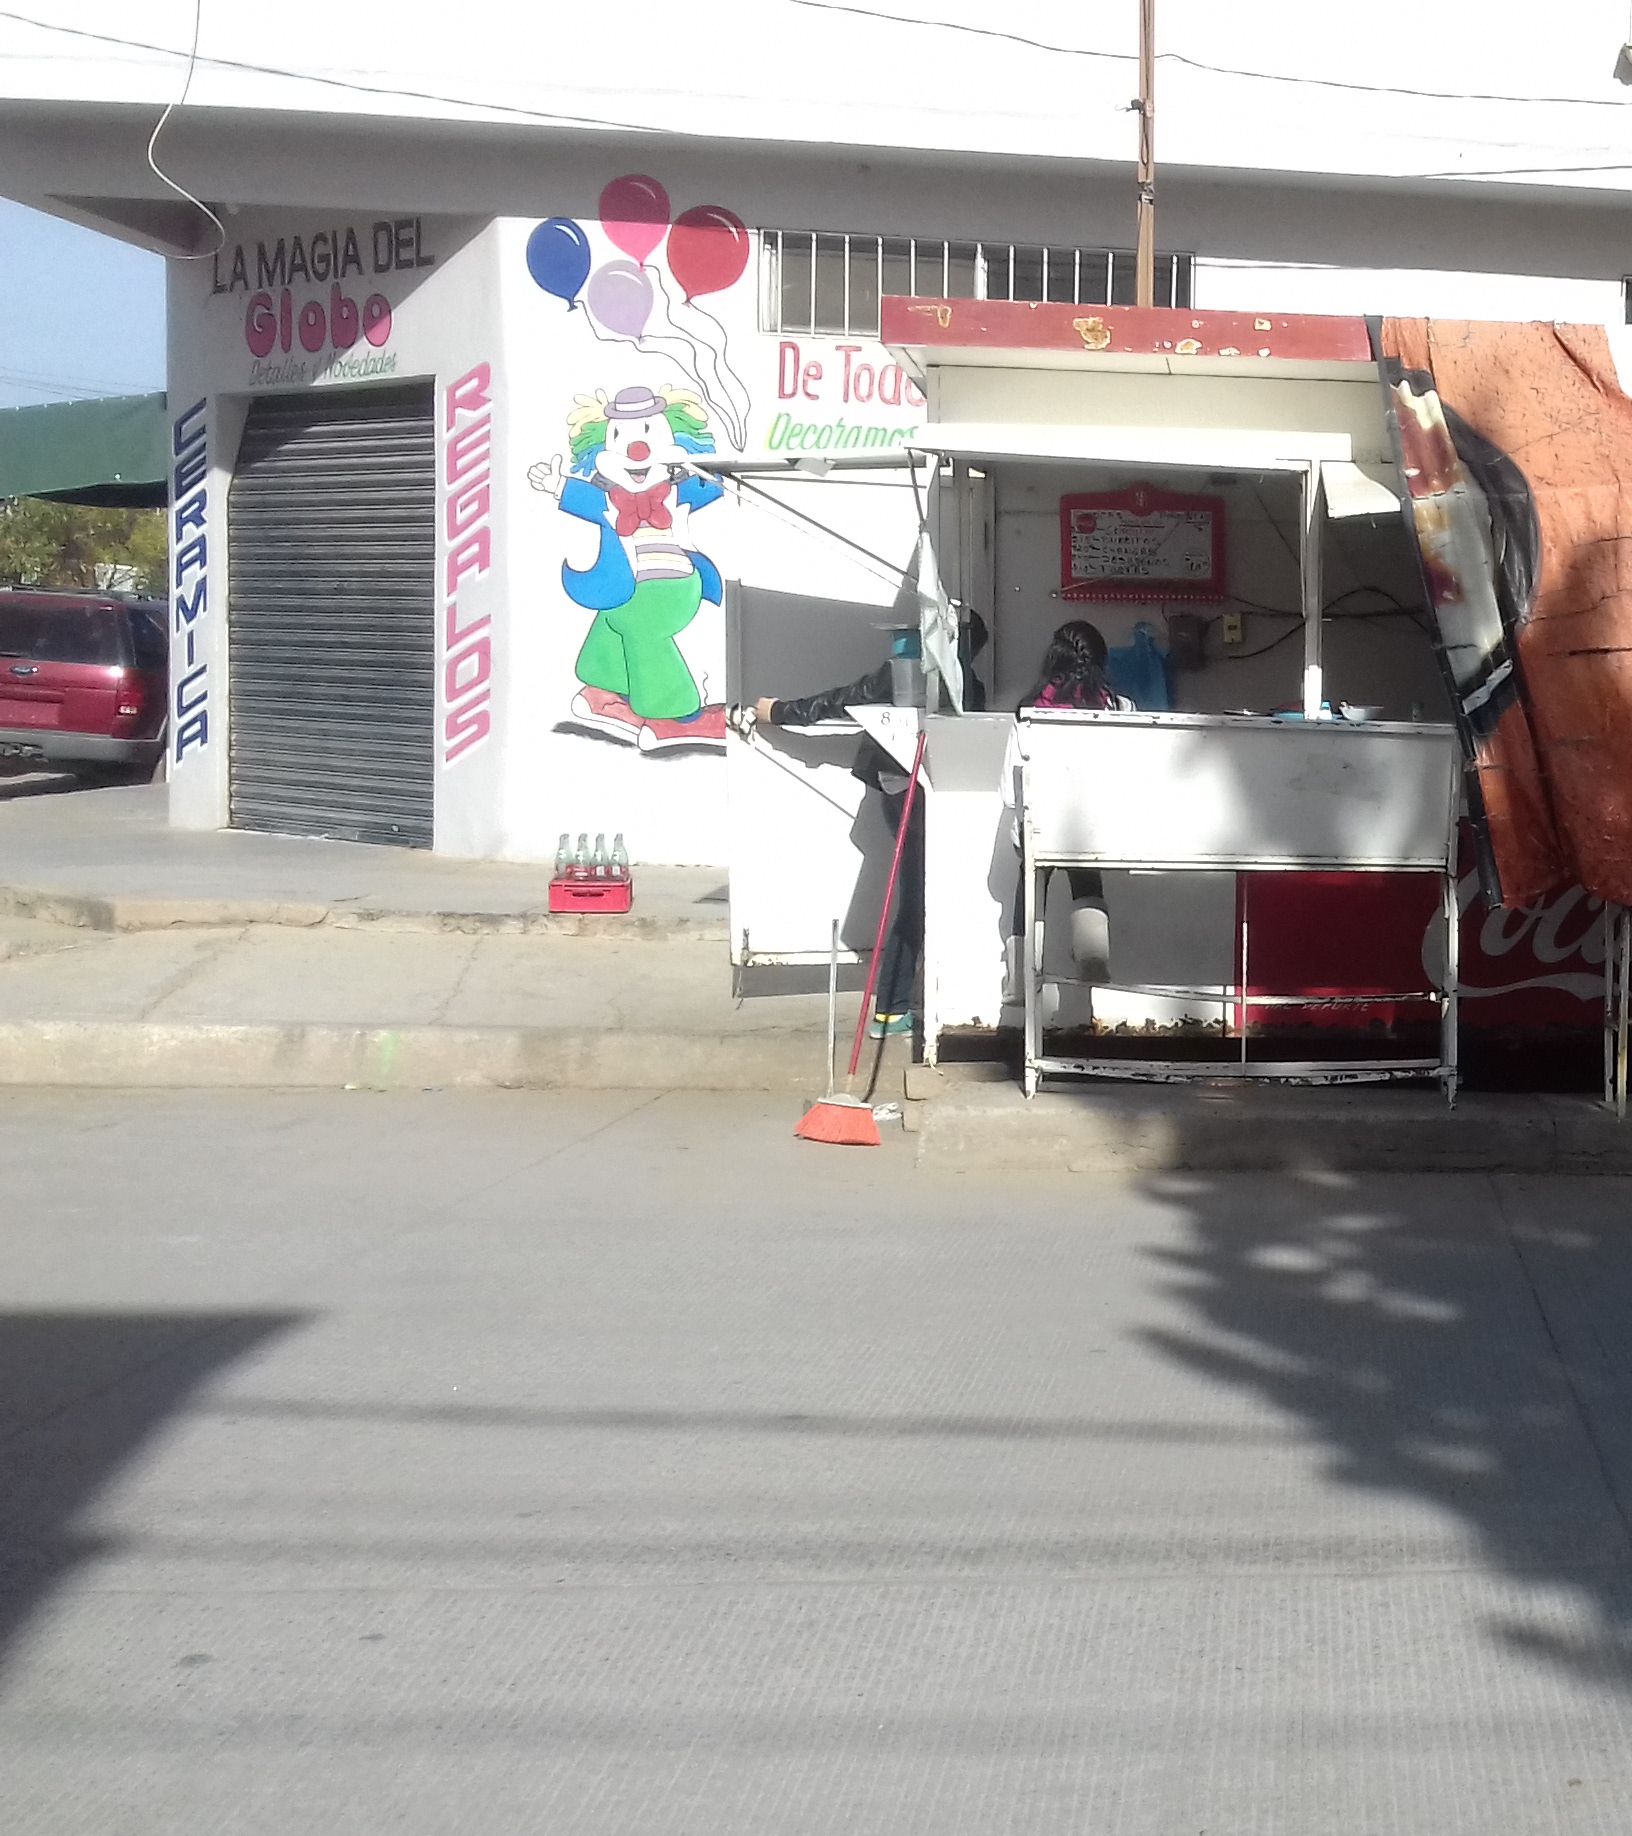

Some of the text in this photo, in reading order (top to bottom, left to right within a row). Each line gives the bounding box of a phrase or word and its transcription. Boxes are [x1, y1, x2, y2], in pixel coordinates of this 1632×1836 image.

[212, 216, 435, 295] LA MAGIA DEL
[245, 281, 393, 357] Globo
[778, 341, 823, 400] De
[173, 397, 209, 765] CERAMICA
[445, 361, 492, 765] REGALOS
